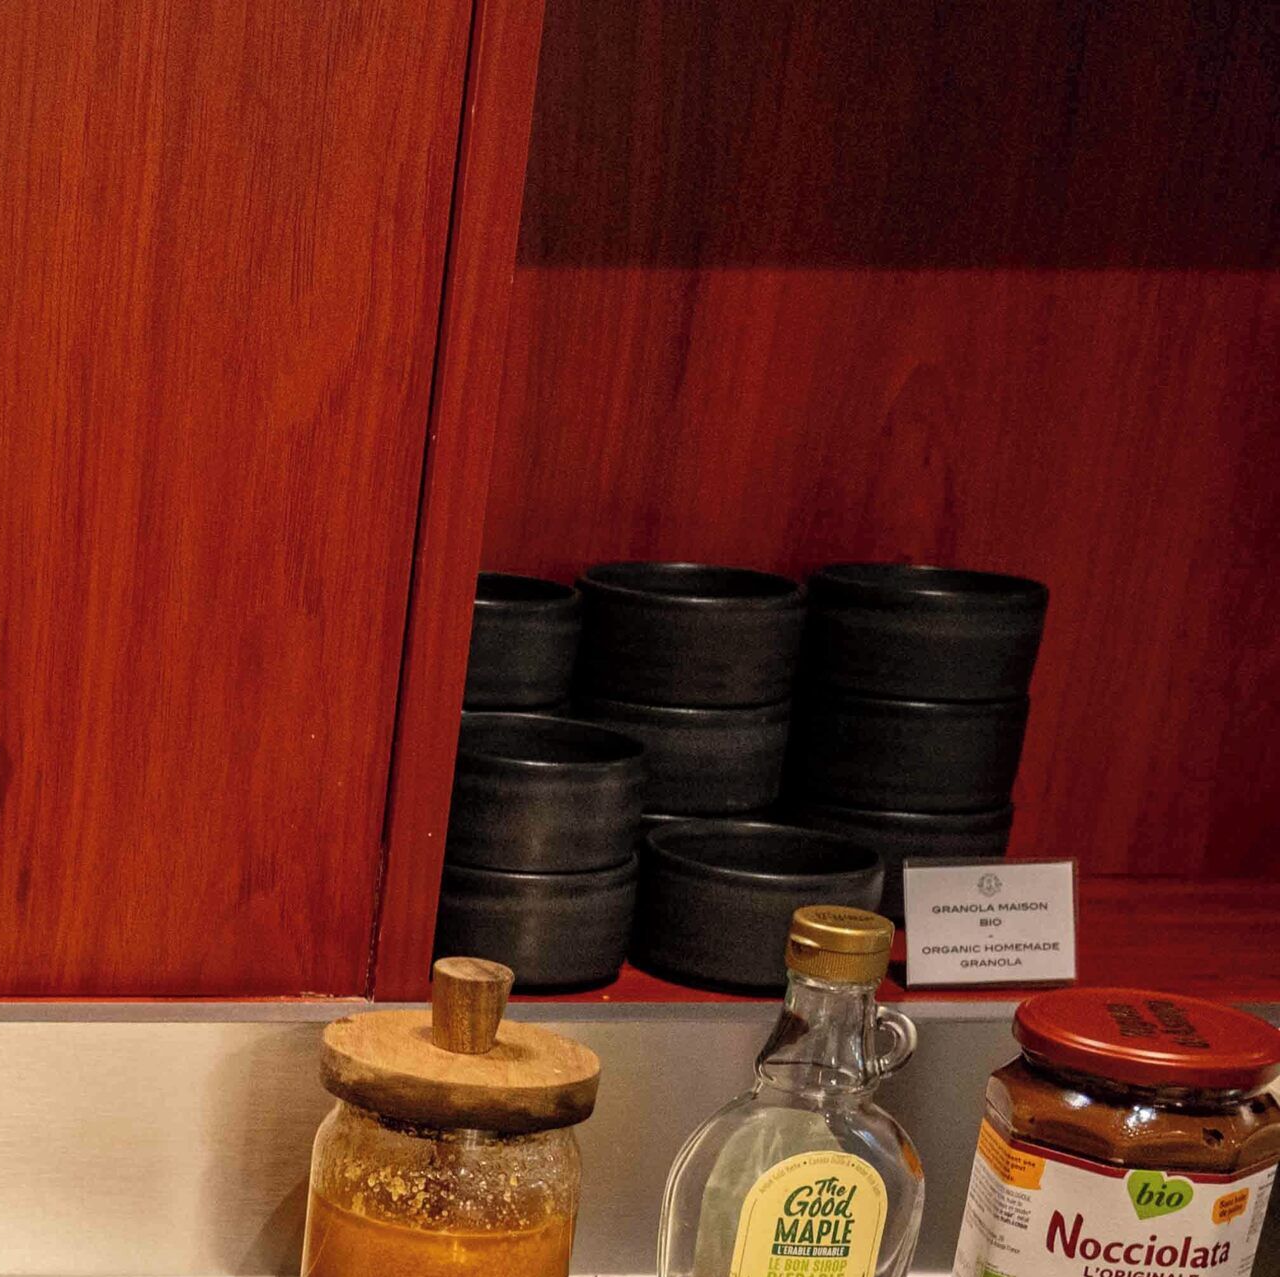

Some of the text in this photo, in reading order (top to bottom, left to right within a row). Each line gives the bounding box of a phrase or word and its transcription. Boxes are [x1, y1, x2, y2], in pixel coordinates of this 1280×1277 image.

[932, 902, 1048, 914] GRANOLA MAISON
[979, 918, 1002, 927] BIO
[922, 942, 1060, 955] ORGANIC HOMEMADE
[960, 958, 1022, 968] GRANOLA
[814, 1176, 846, 1197] The
[783, 1185, 857, 1218] Good
[1136, 1181, 1185, 1209] bio
[773, 1217, 855, 1244] MAPLE
[1046, 1209, 1230, 1269] Nocciolata
[812, 1247, 845, 1256] DURABLE
[768, 1257, 847, 1273] LE BON SIROP
